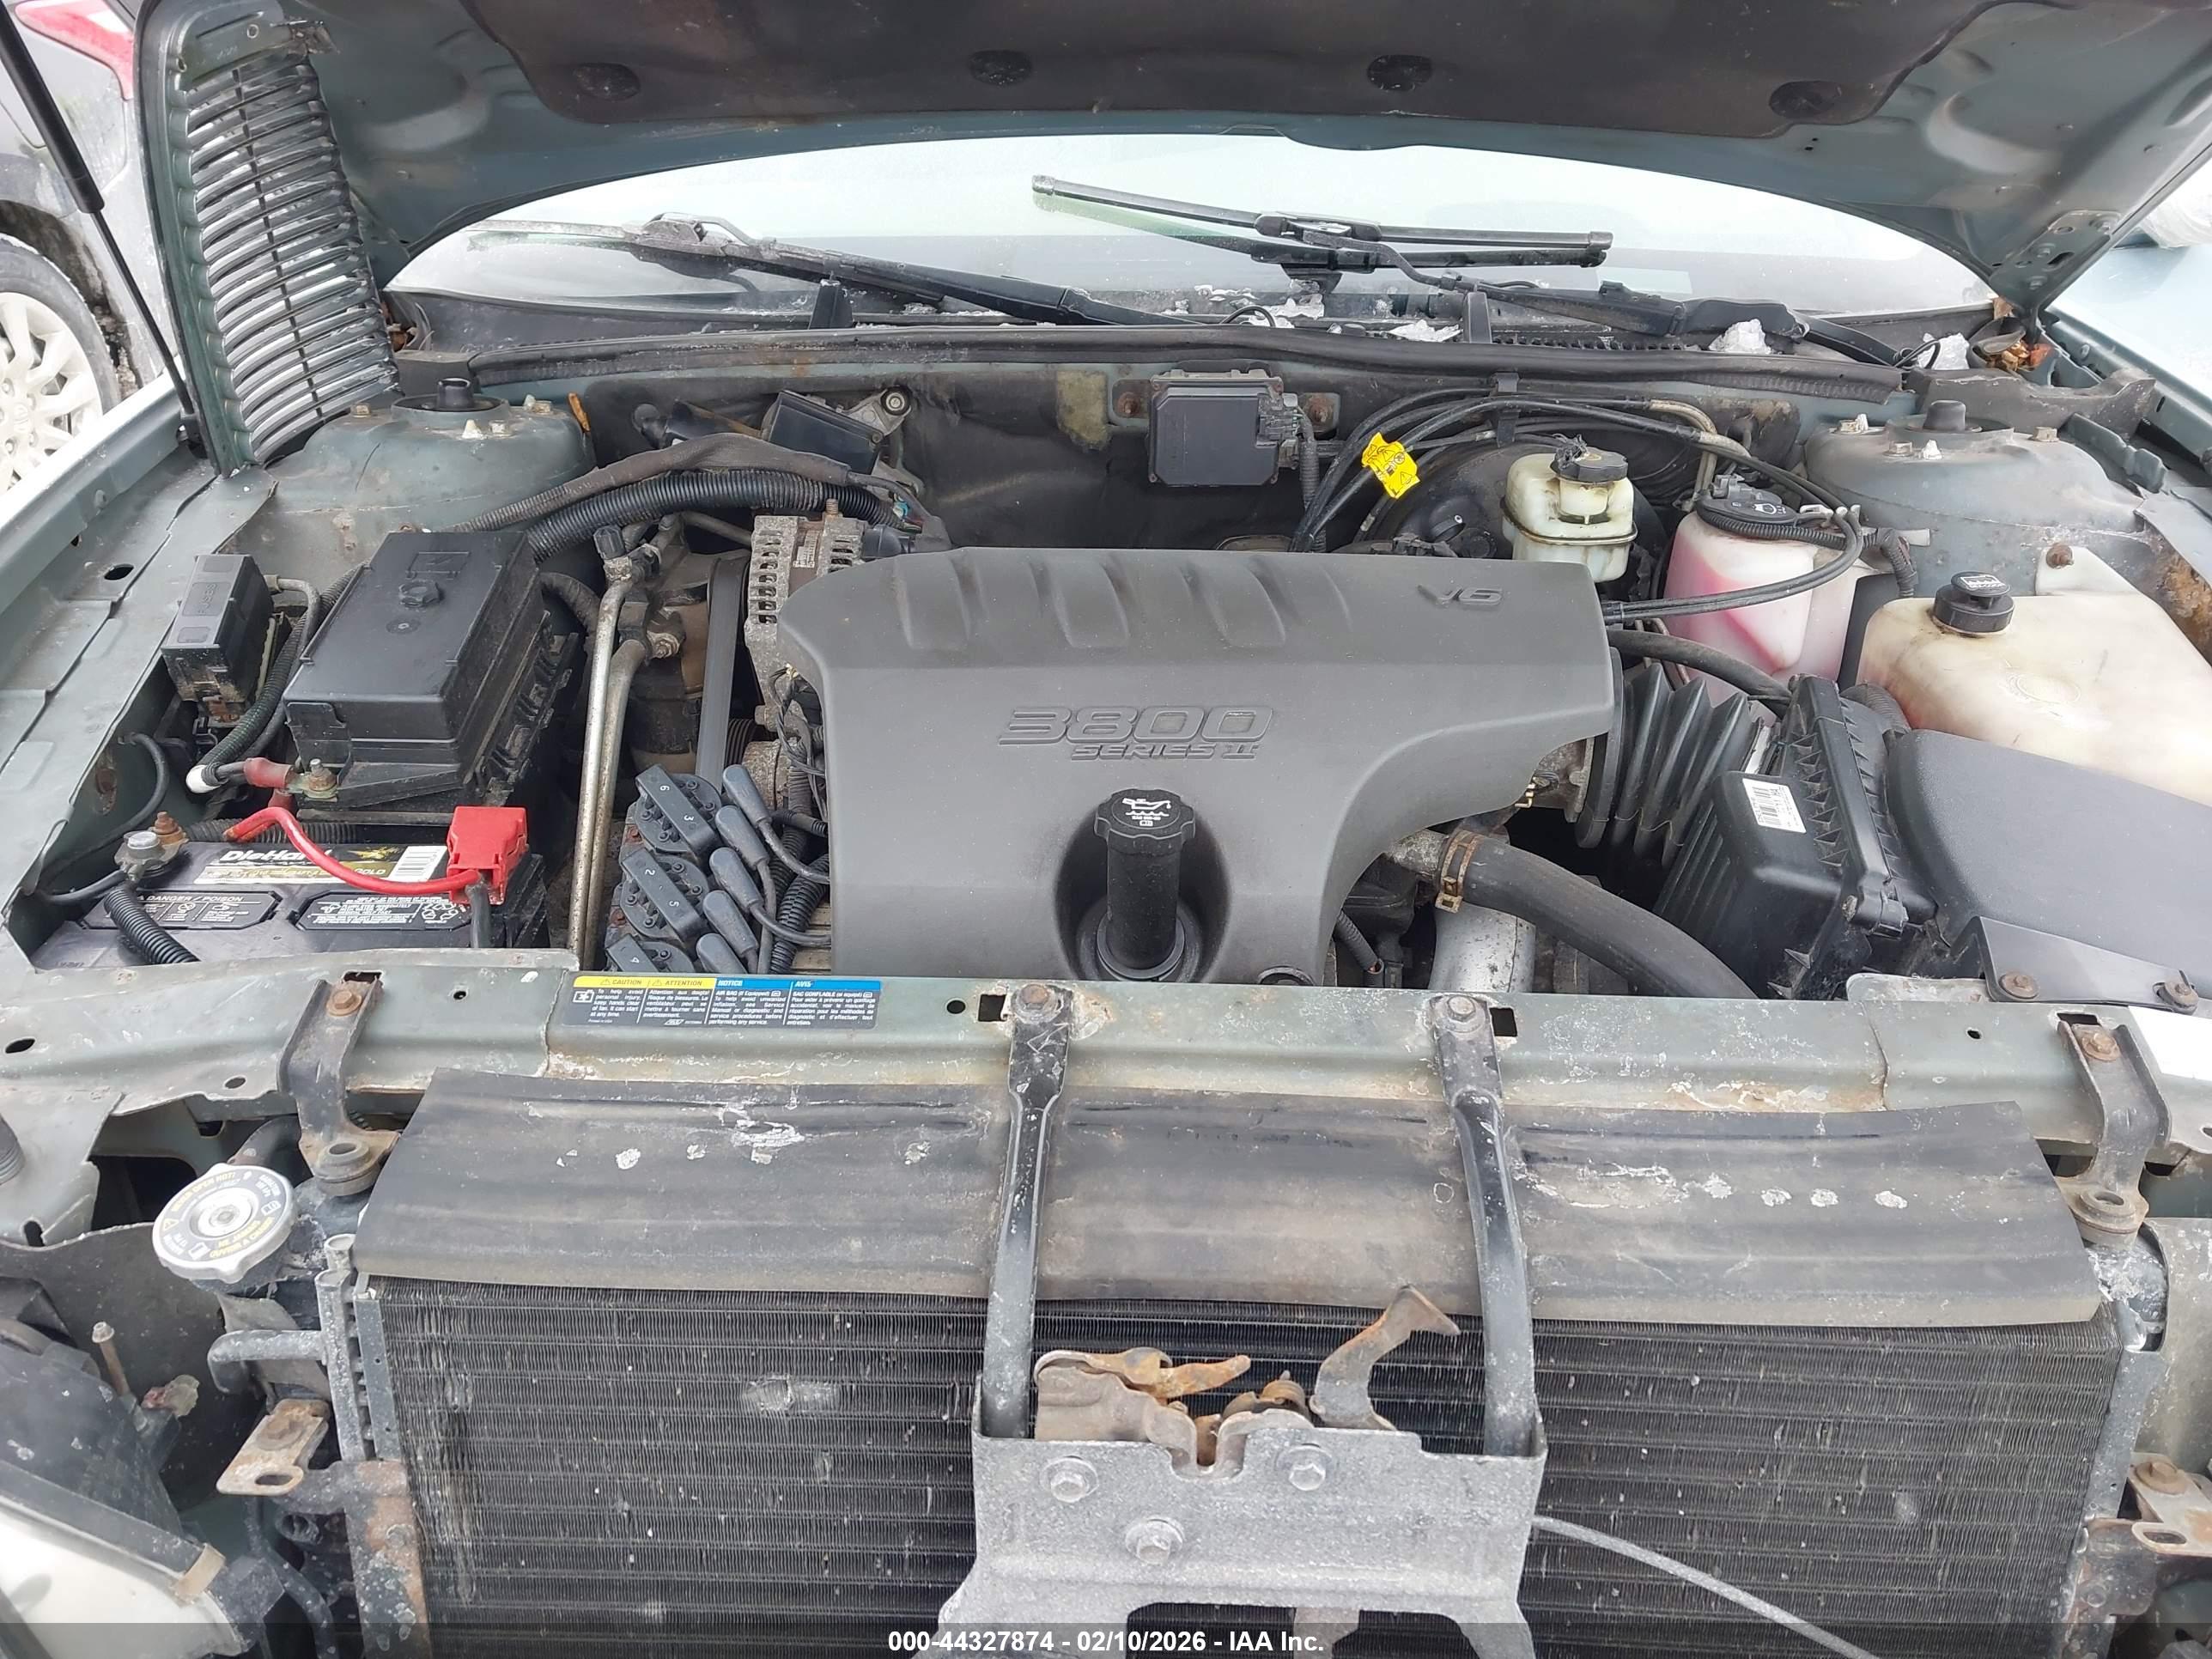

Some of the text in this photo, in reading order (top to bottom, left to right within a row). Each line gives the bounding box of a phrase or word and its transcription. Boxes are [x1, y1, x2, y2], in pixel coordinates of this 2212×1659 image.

[998, 706, 1274, 745] 3800
[1071, 744, 1259, 761] SERIES II
